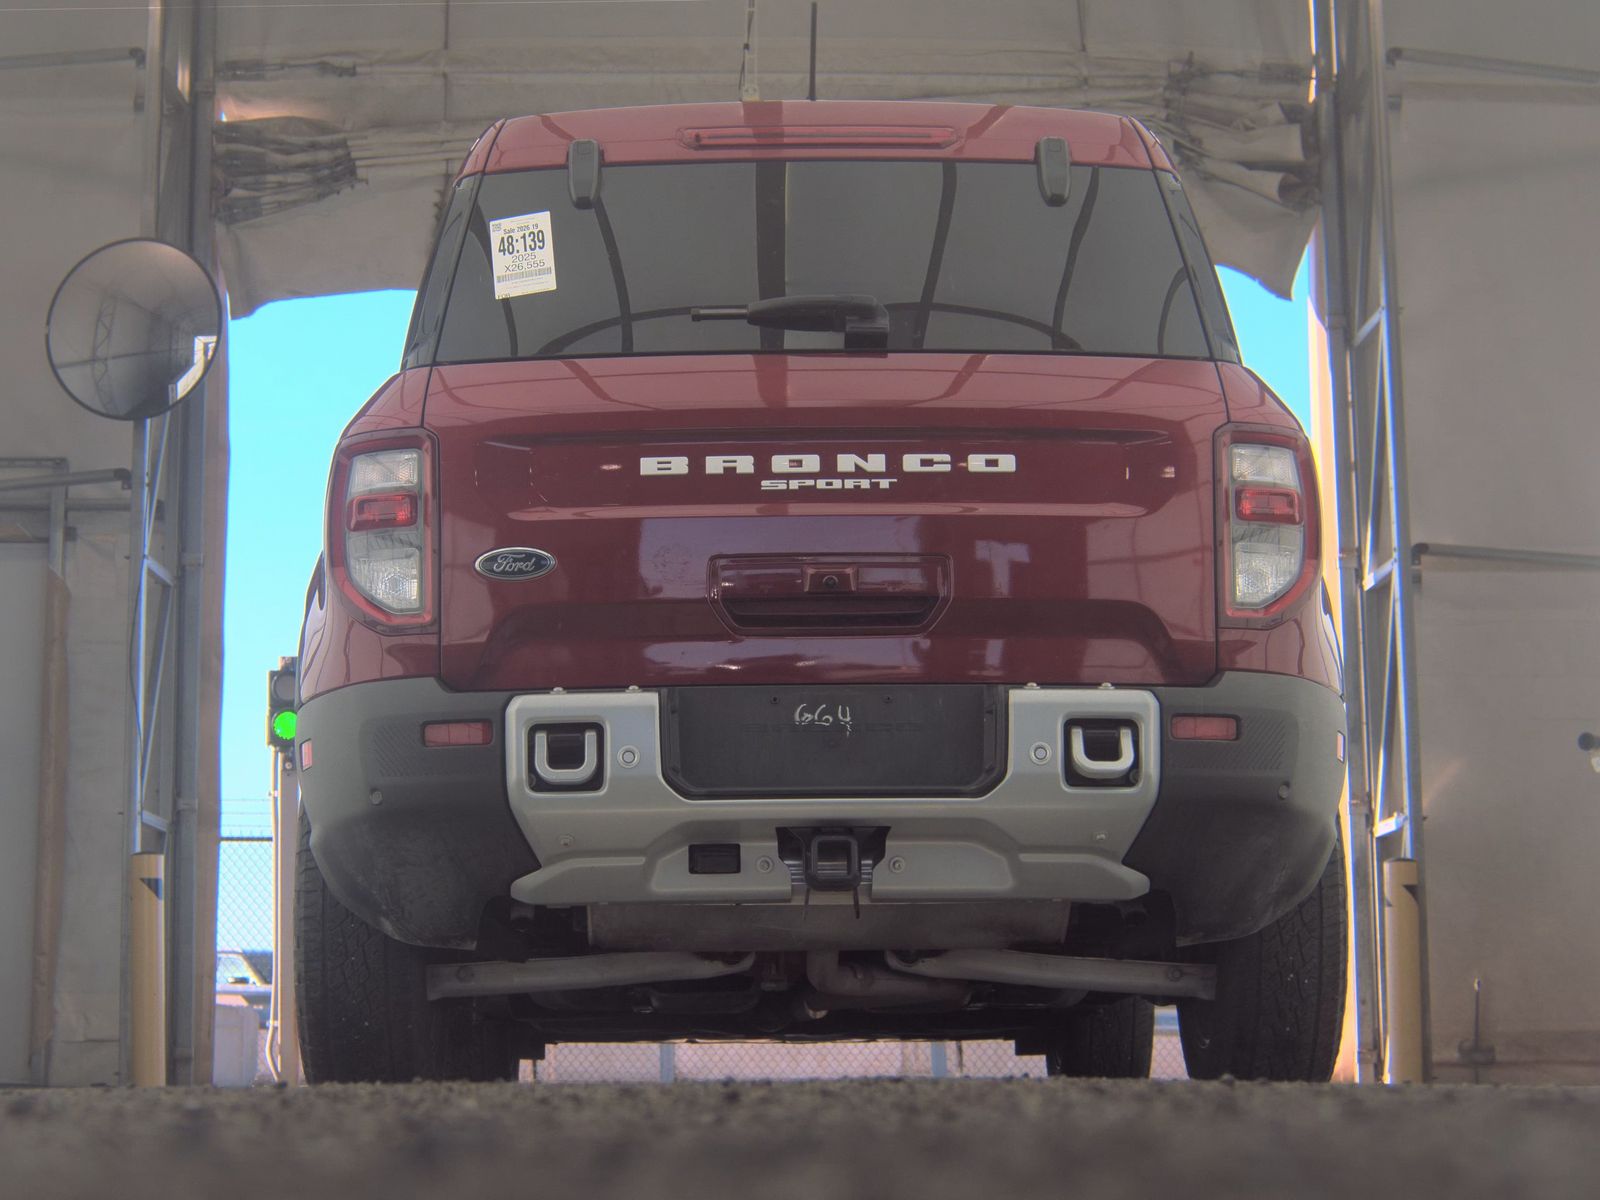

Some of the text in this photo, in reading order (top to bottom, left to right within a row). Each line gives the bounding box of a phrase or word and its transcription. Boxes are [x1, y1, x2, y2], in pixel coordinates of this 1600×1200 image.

[498, 230, 545, 256] 48:139
[512, 252, 536, 263] 2025
[504, 260, 545, 273] X26,555
[640, 453, 1016, 475] BRONCO
[760, 478, 898, 491] SPORT
[493, 554, 536, 573] Ford
